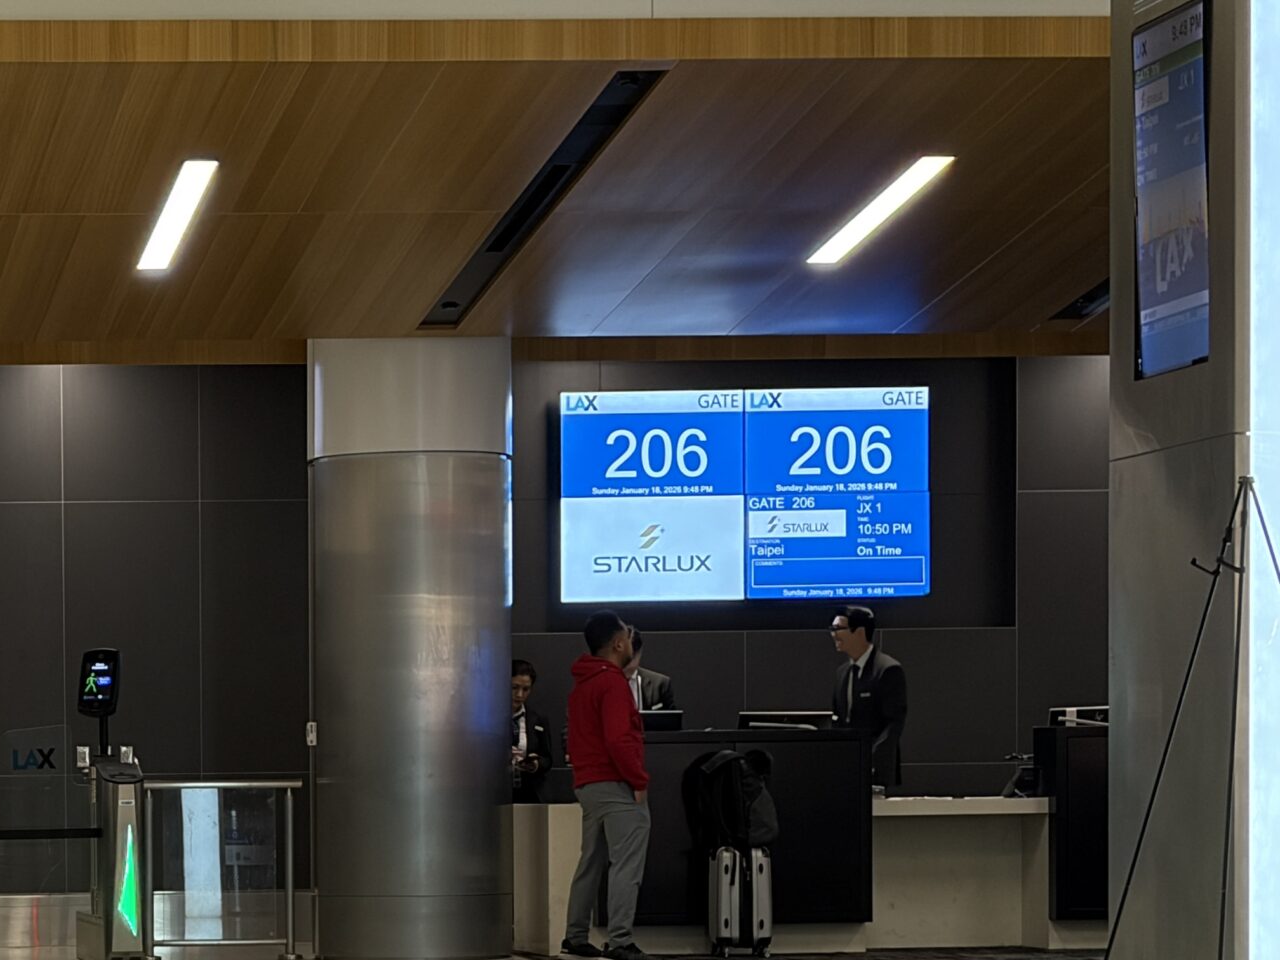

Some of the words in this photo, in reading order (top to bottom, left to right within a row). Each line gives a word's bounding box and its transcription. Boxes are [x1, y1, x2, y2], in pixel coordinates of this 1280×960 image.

[566, 395, 598, 411] LAX
[698, 394, 740, 409] GATE
[750, 392, 782, 409] LAX
[882, 391, 924, 406] GATE
[605, 428, 708, 479] 206
[789, 425, 892, 476] 206
[592, 487, 619, 495] Sunday
[620, 487, 649, 495] January
[700, 485, 713, 493] PM
[776, 484, 803, 492] Sunday
[804, 484, 834, 492] January
[884, 482, 897, 490] PM
[749, 497, 785, 509] GATE
[792, 497, 816, 508] 206
[856, 502, 872, 514] JX
[875, 502, 882, 513] 1
[783, 523, 829, 533] STARLUX
[858, 524, 890, 535] 10:50
[892, 523, 912, 534] PM
[749, 544, 785, 557] Taipei
[857, 546, 873, 556] On
[875, 545, 902, 555] Time
[593, 554, 711, 573] STARLUX
[783, 589, 807, 597] Sunday
[808, 588, 833, 597] January
[12, 747, 56, 770] LAX
